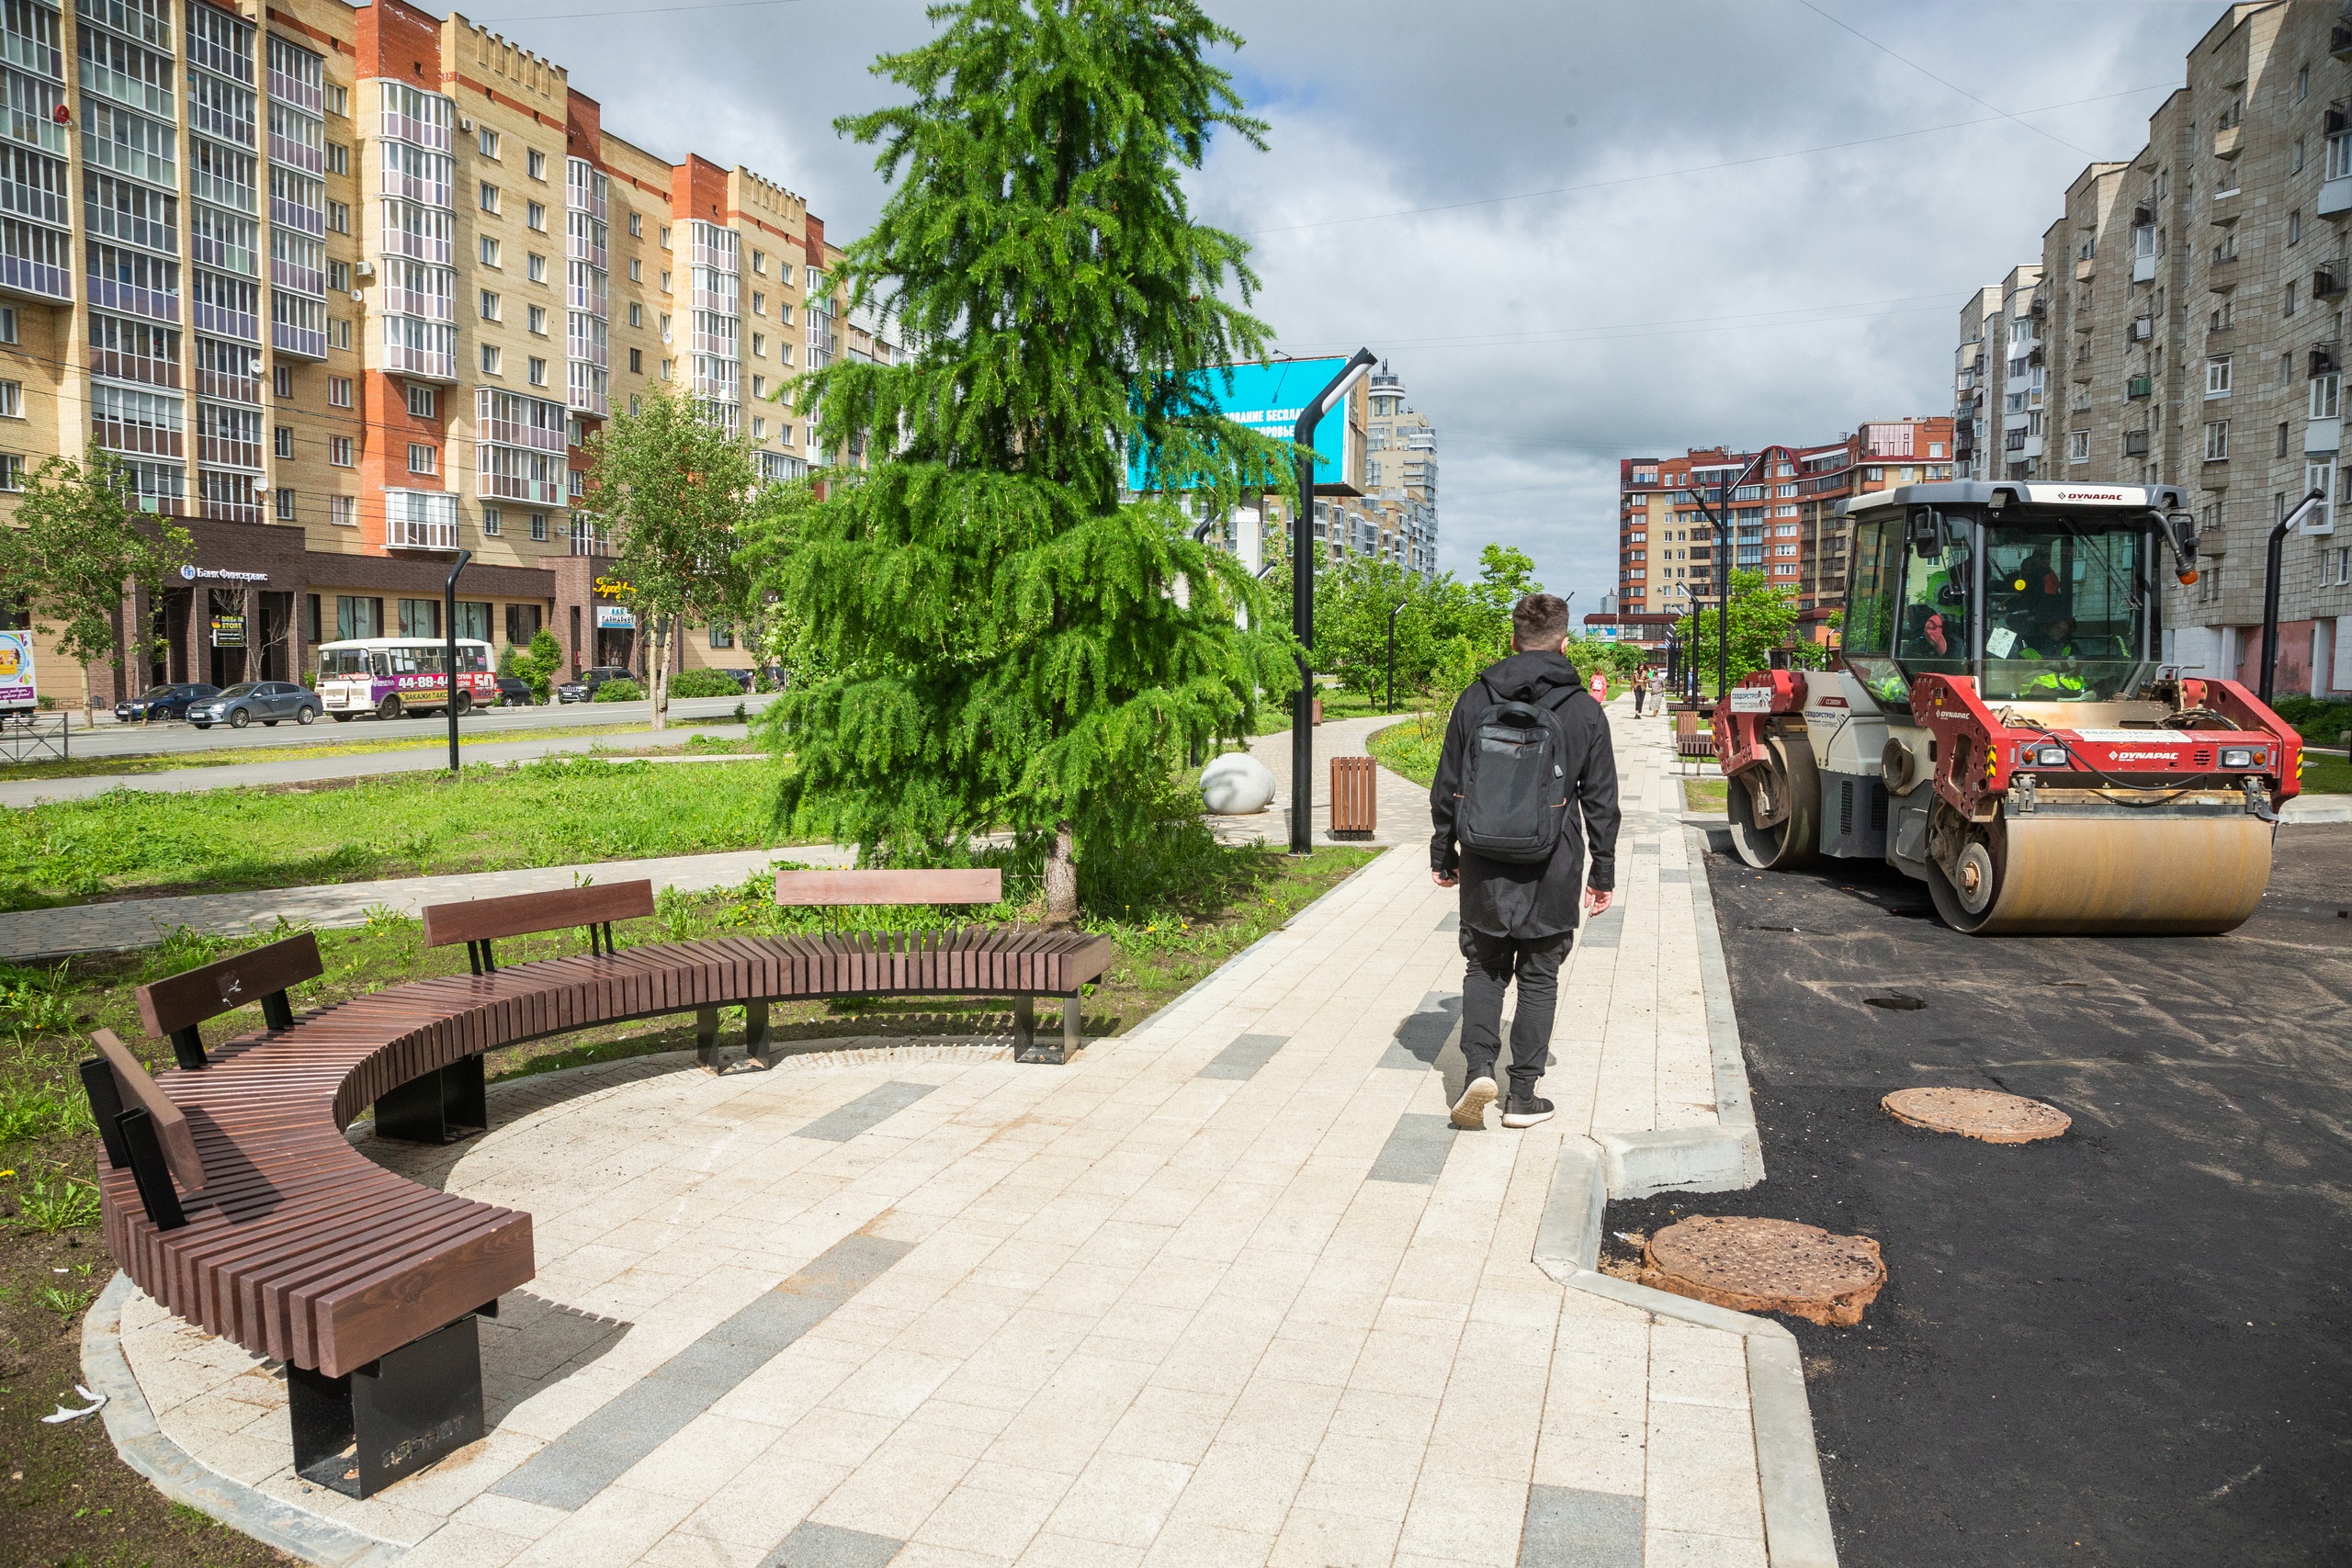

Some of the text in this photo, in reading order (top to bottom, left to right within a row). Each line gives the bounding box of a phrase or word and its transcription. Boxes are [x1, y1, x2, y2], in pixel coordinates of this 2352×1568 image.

[197, 568, 268, 581] Банк Финсервис
[405, 690, 448, 700] ЗАКАЖИ ТАКС
[1804, 710, 1836, 719] СЕВДОРСТРОЙ
[1940, 711, 1970, 720] DYNAPAC
